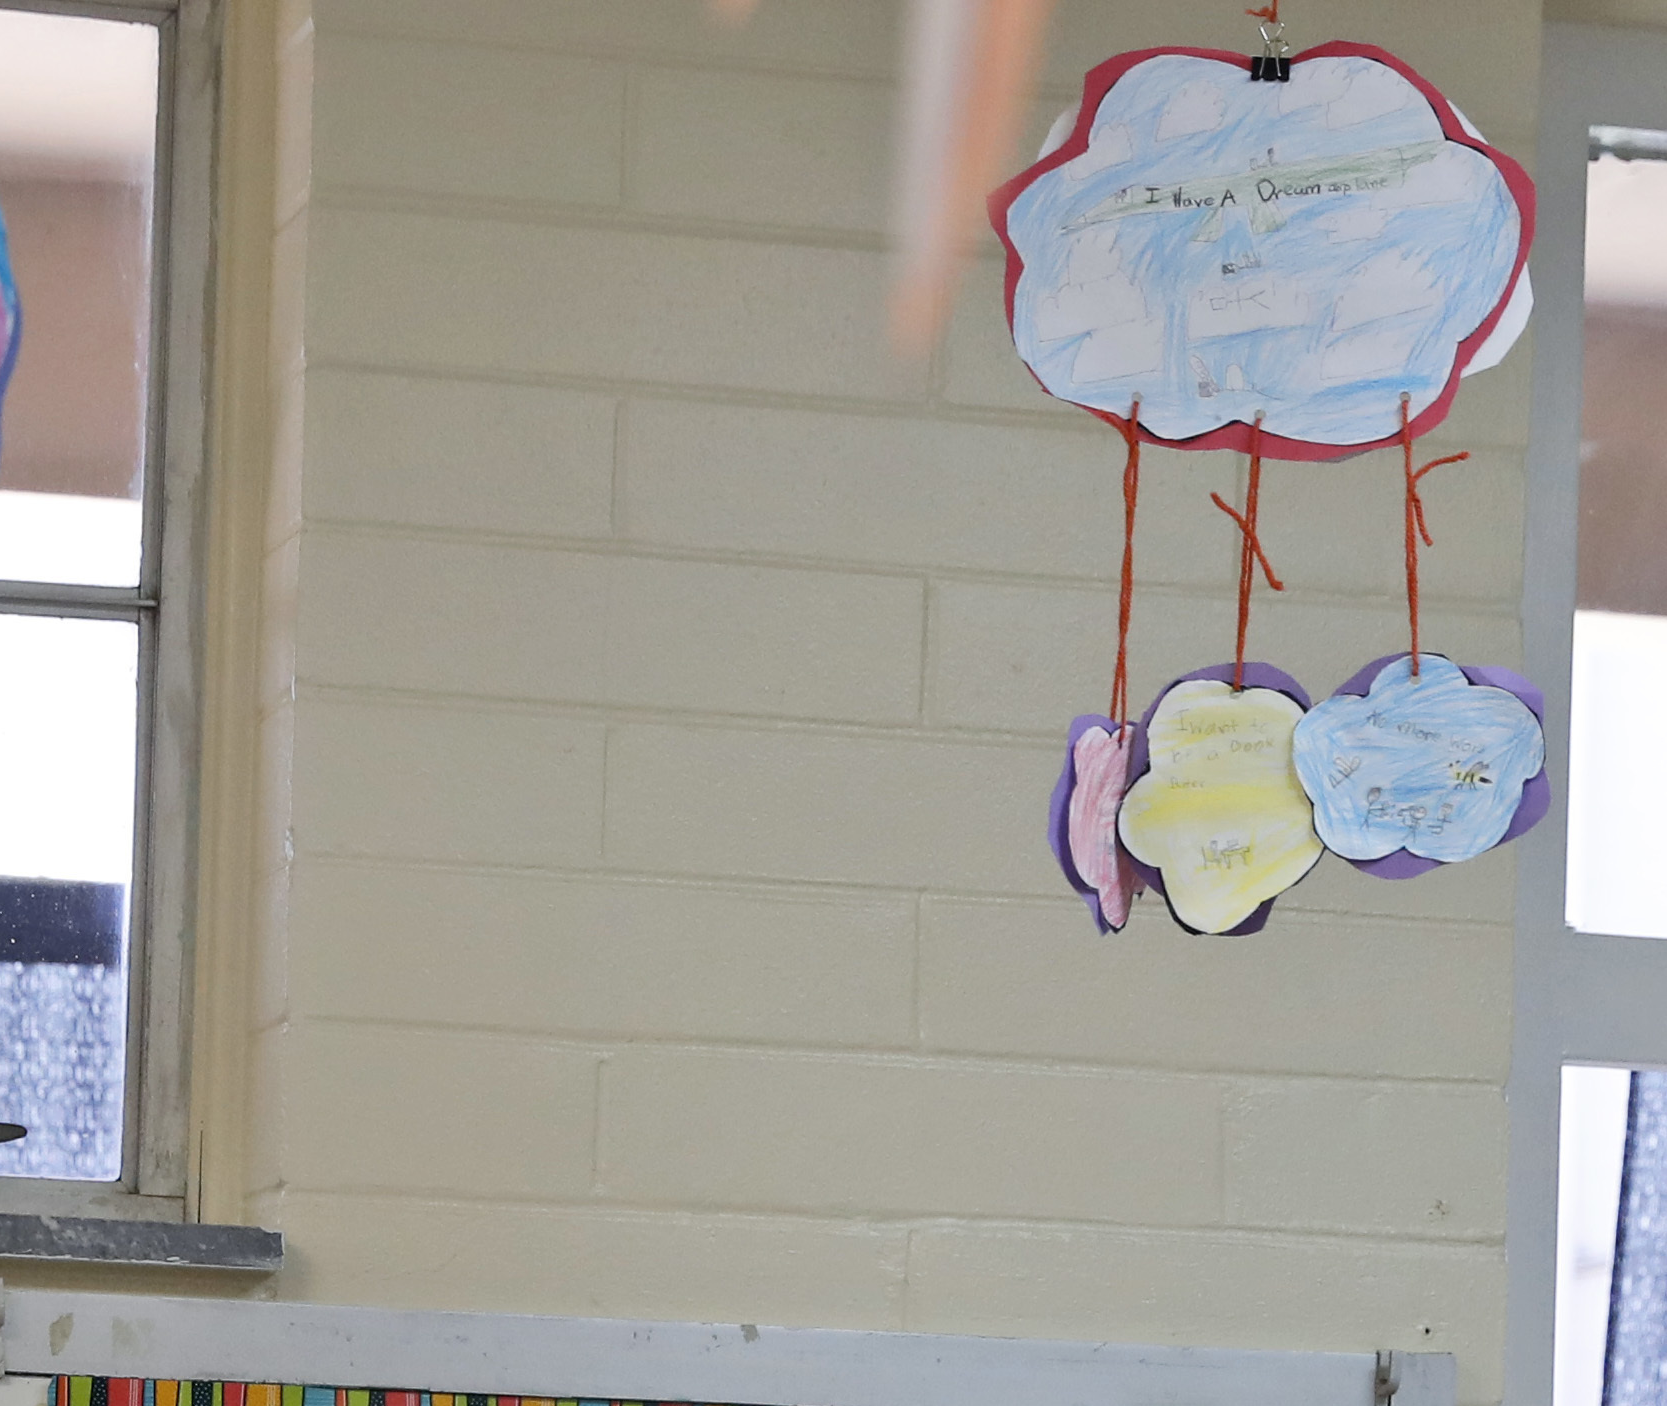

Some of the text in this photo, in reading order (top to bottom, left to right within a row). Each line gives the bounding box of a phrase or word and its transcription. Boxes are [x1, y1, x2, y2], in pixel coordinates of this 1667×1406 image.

[1173, 186, 1214, 207] Have
[1219, 189, 1236, 207] A
[1256, 178, 1321, 202] Dream
